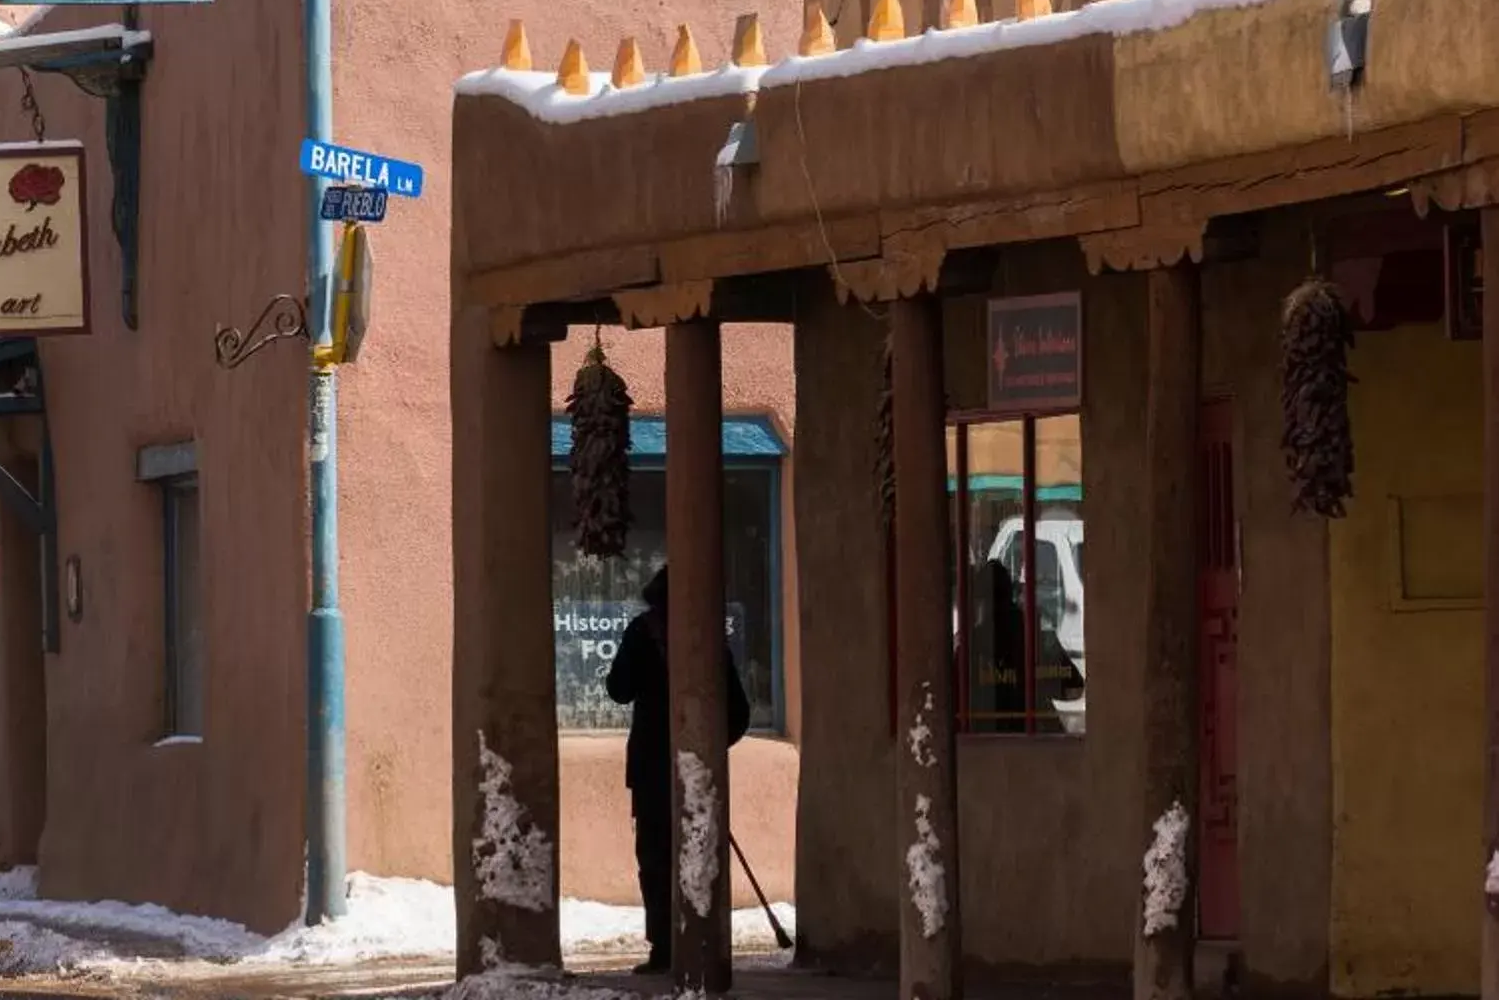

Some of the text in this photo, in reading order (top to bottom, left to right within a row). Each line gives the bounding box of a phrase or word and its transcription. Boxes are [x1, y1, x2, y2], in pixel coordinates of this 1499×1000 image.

[311, 144, 413, 193] BARELA LN
[0, 293, 43, 315] art
[553, 612, 629, 633] Histori
